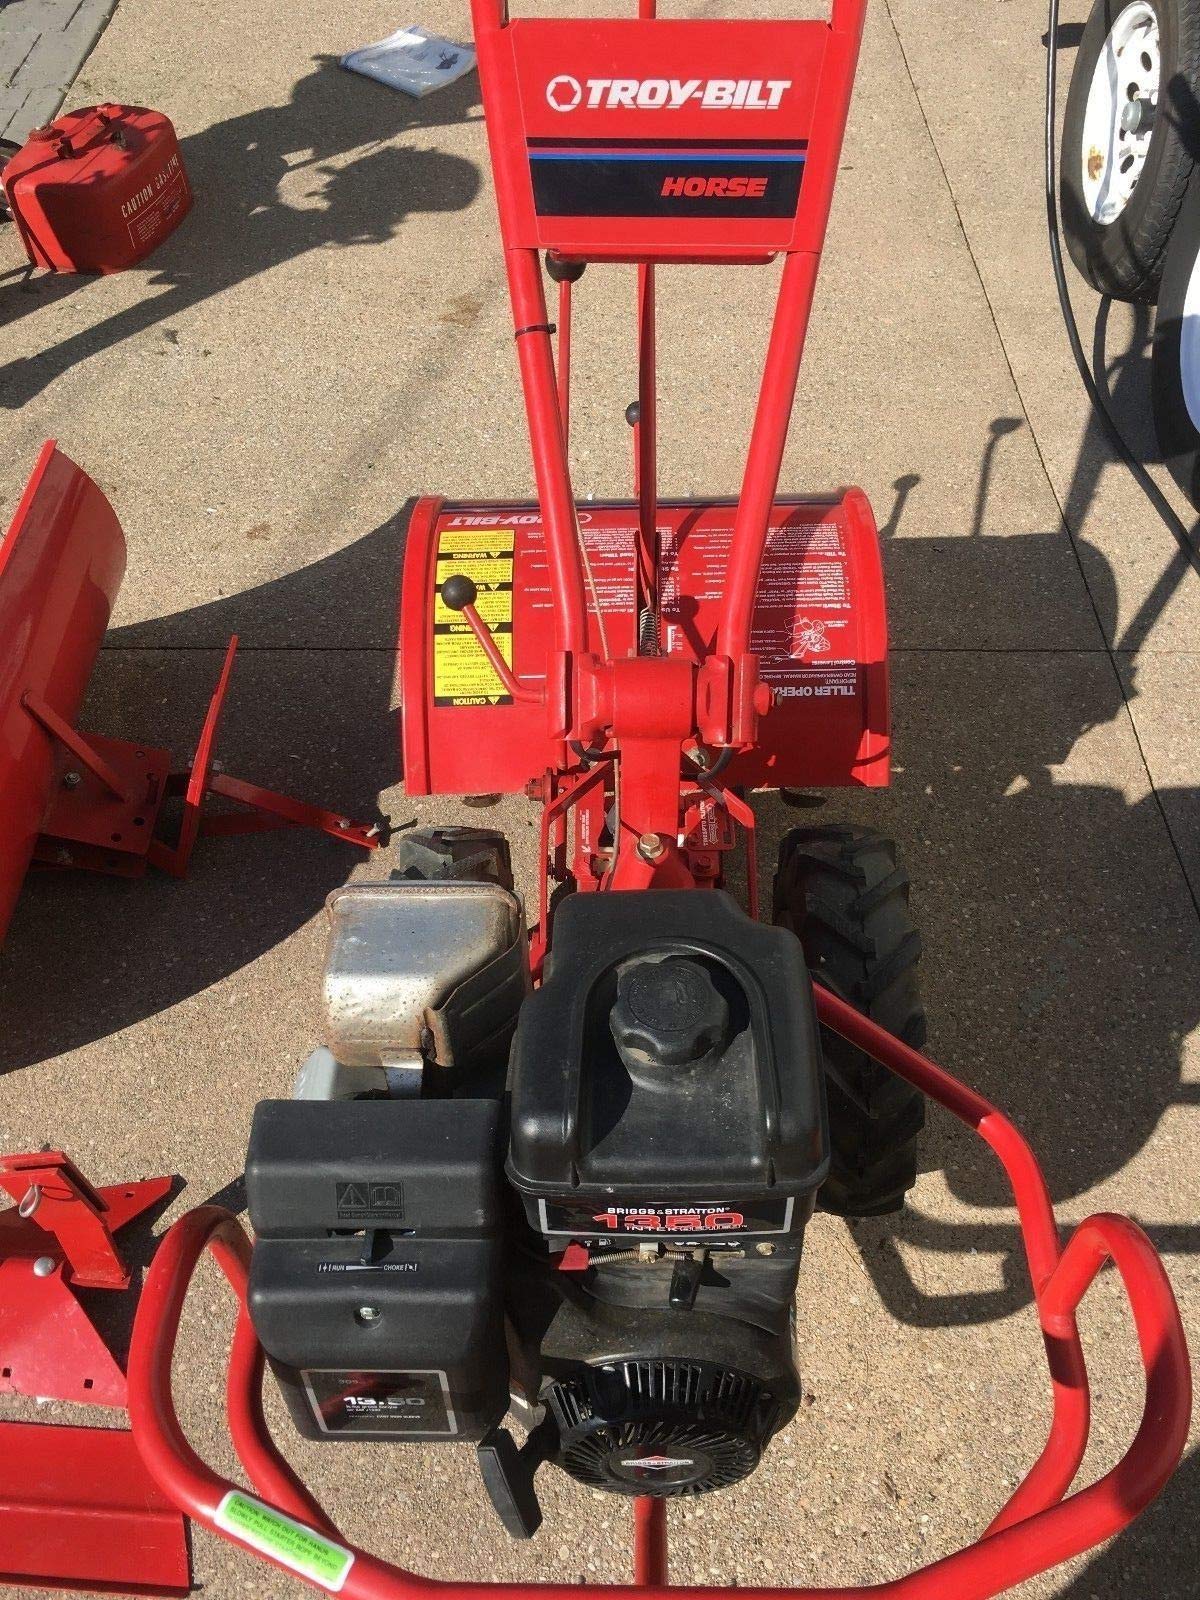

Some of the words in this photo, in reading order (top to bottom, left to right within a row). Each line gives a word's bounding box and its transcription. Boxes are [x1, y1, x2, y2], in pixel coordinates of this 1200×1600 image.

[586, 79, 793, 111] TROY-BILT
[660, 176, 769, 198] HORSE
[121, 183, 155, 218] CAUTION
[447, 515, 543, 526] OY-BILT
[450, 624, 472, 632] NING
[814, 686, 856, 696] TILLER
[452, 697, 487, 705] CAUTION
[607, 1207, 655, 1215] BRIGGS
[664, 1207, 725, 1215] STRATTON
[592, 1213, 744, 1230] 1350
